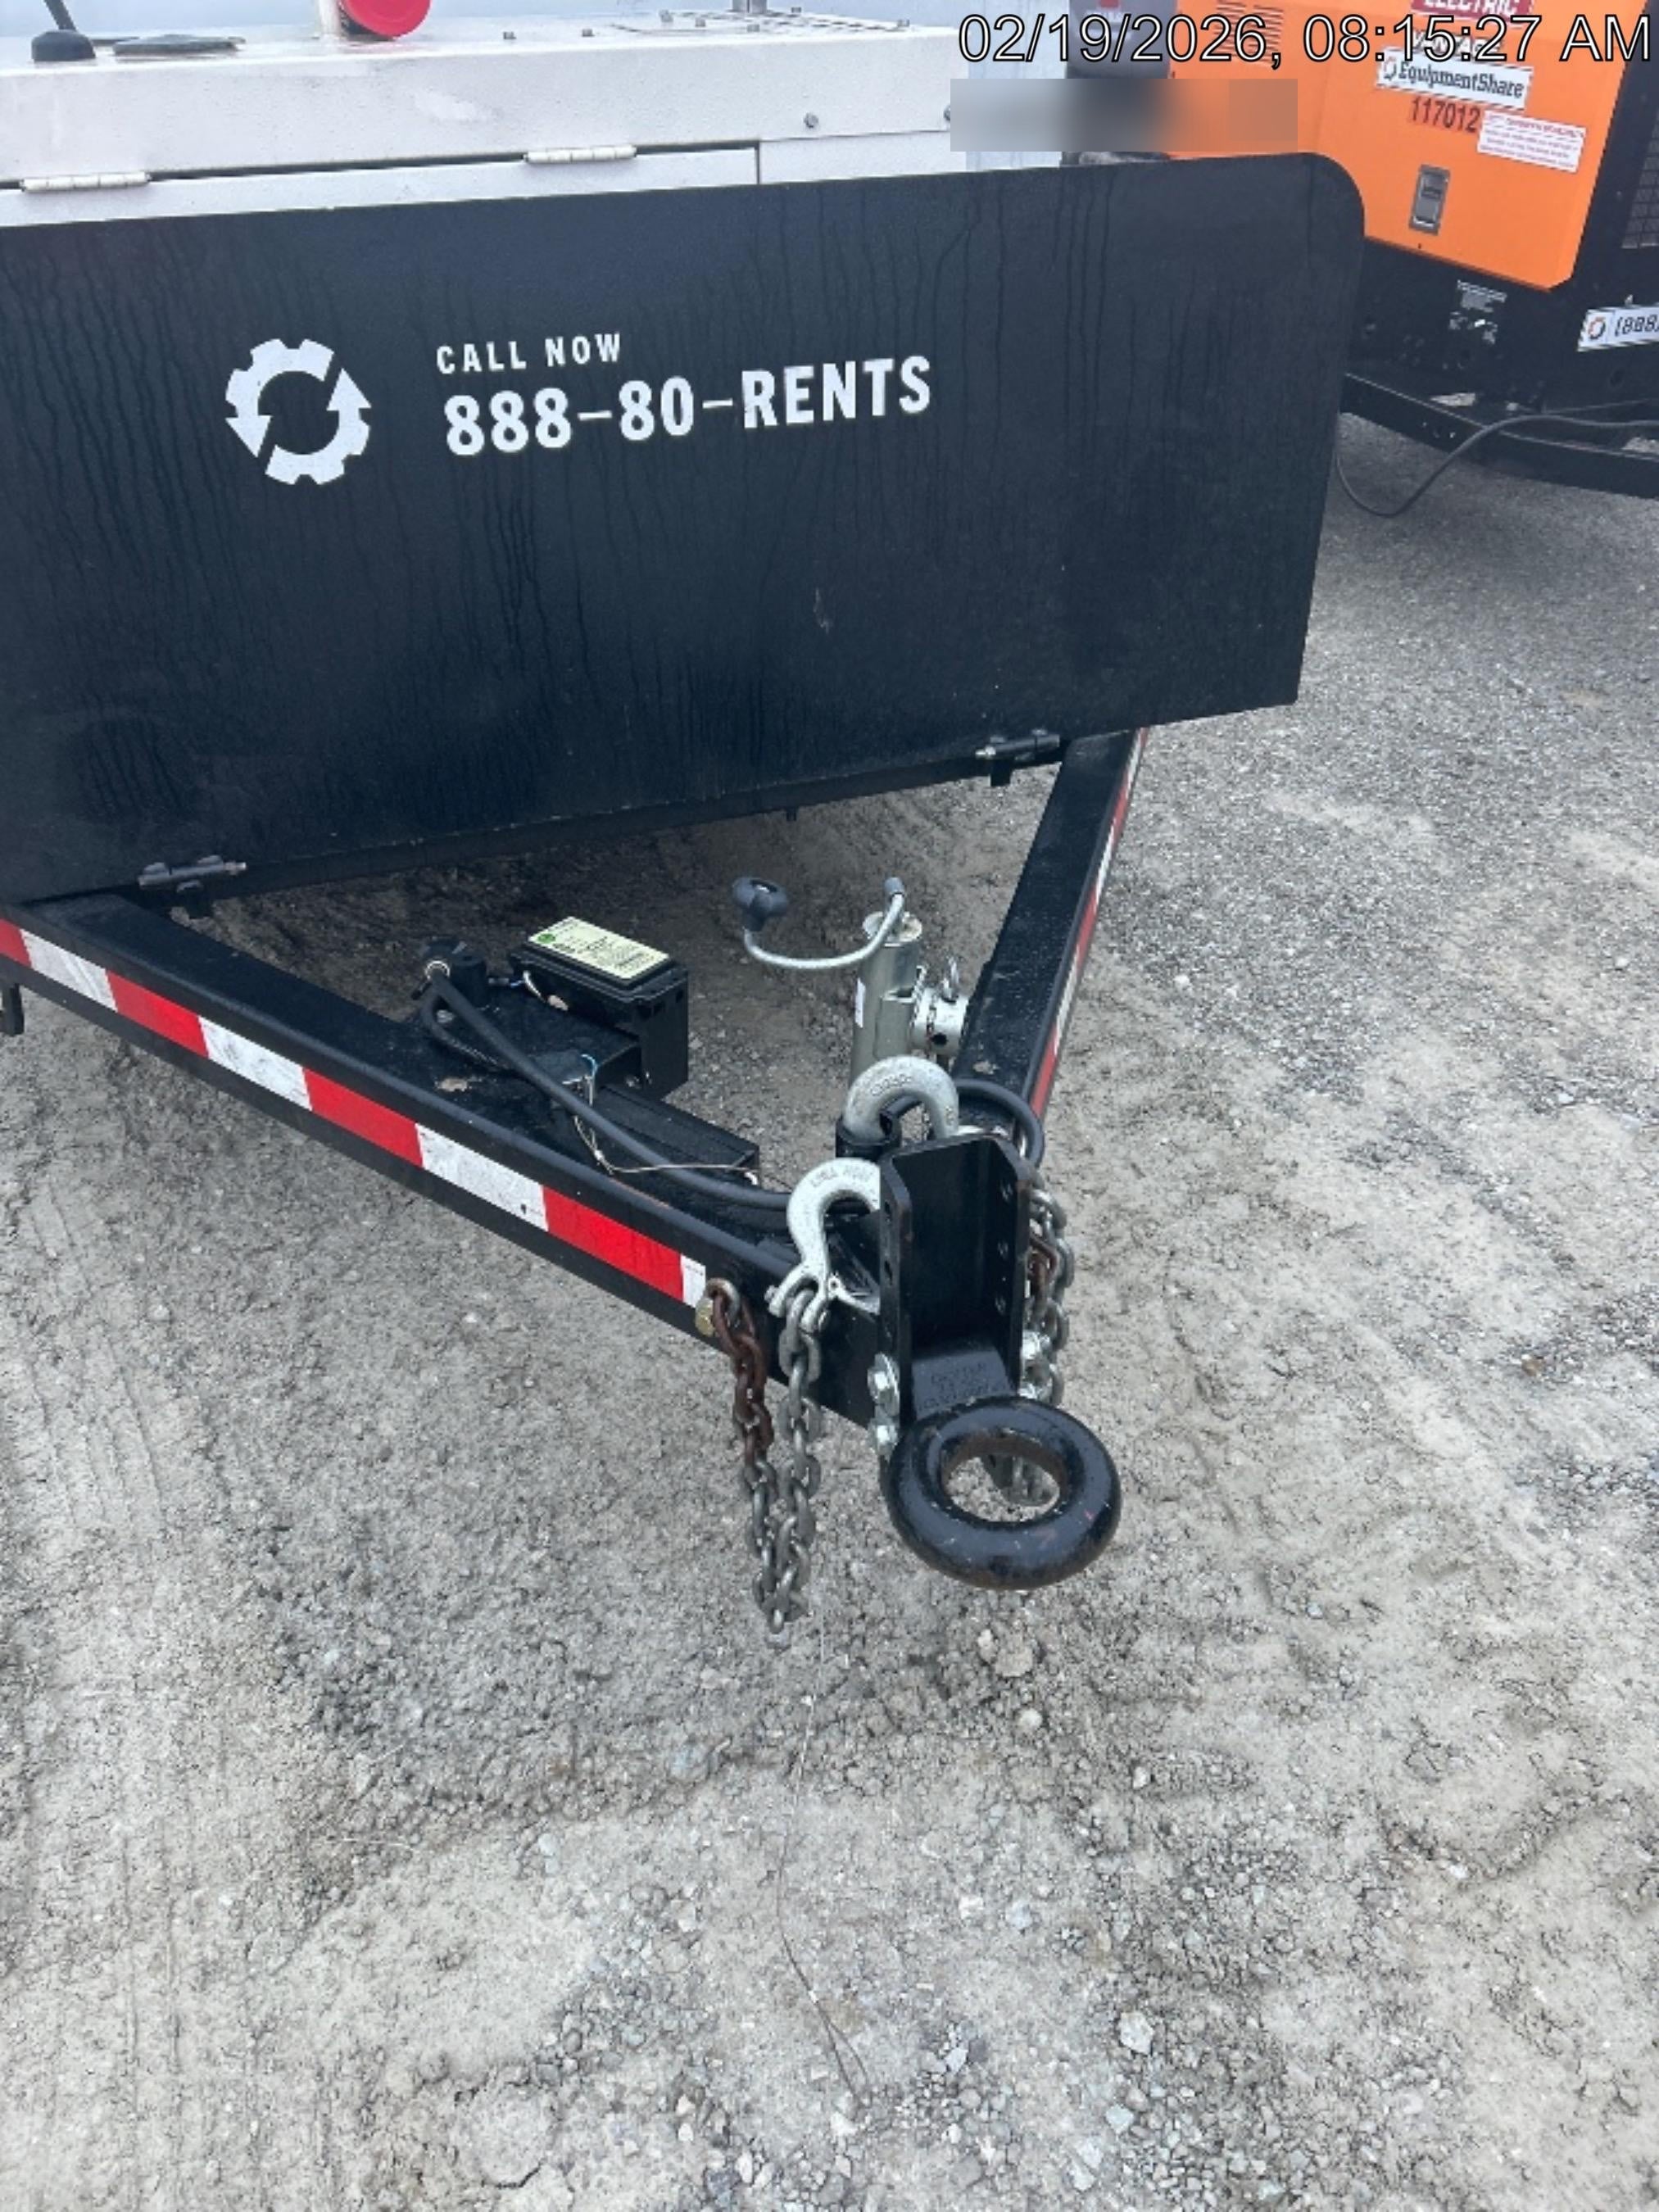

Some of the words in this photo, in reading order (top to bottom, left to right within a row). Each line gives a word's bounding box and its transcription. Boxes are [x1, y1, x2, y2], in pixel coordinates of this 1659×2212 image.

[1398, 61, 1525, 99] EquipmentShare
[1411, 96, 1481, 133] 117012
[437, 340, 528, 374] CALL
[545, 333, 621, 367] NOW
[444, 355, 931, 456] 888-80-RENTS
